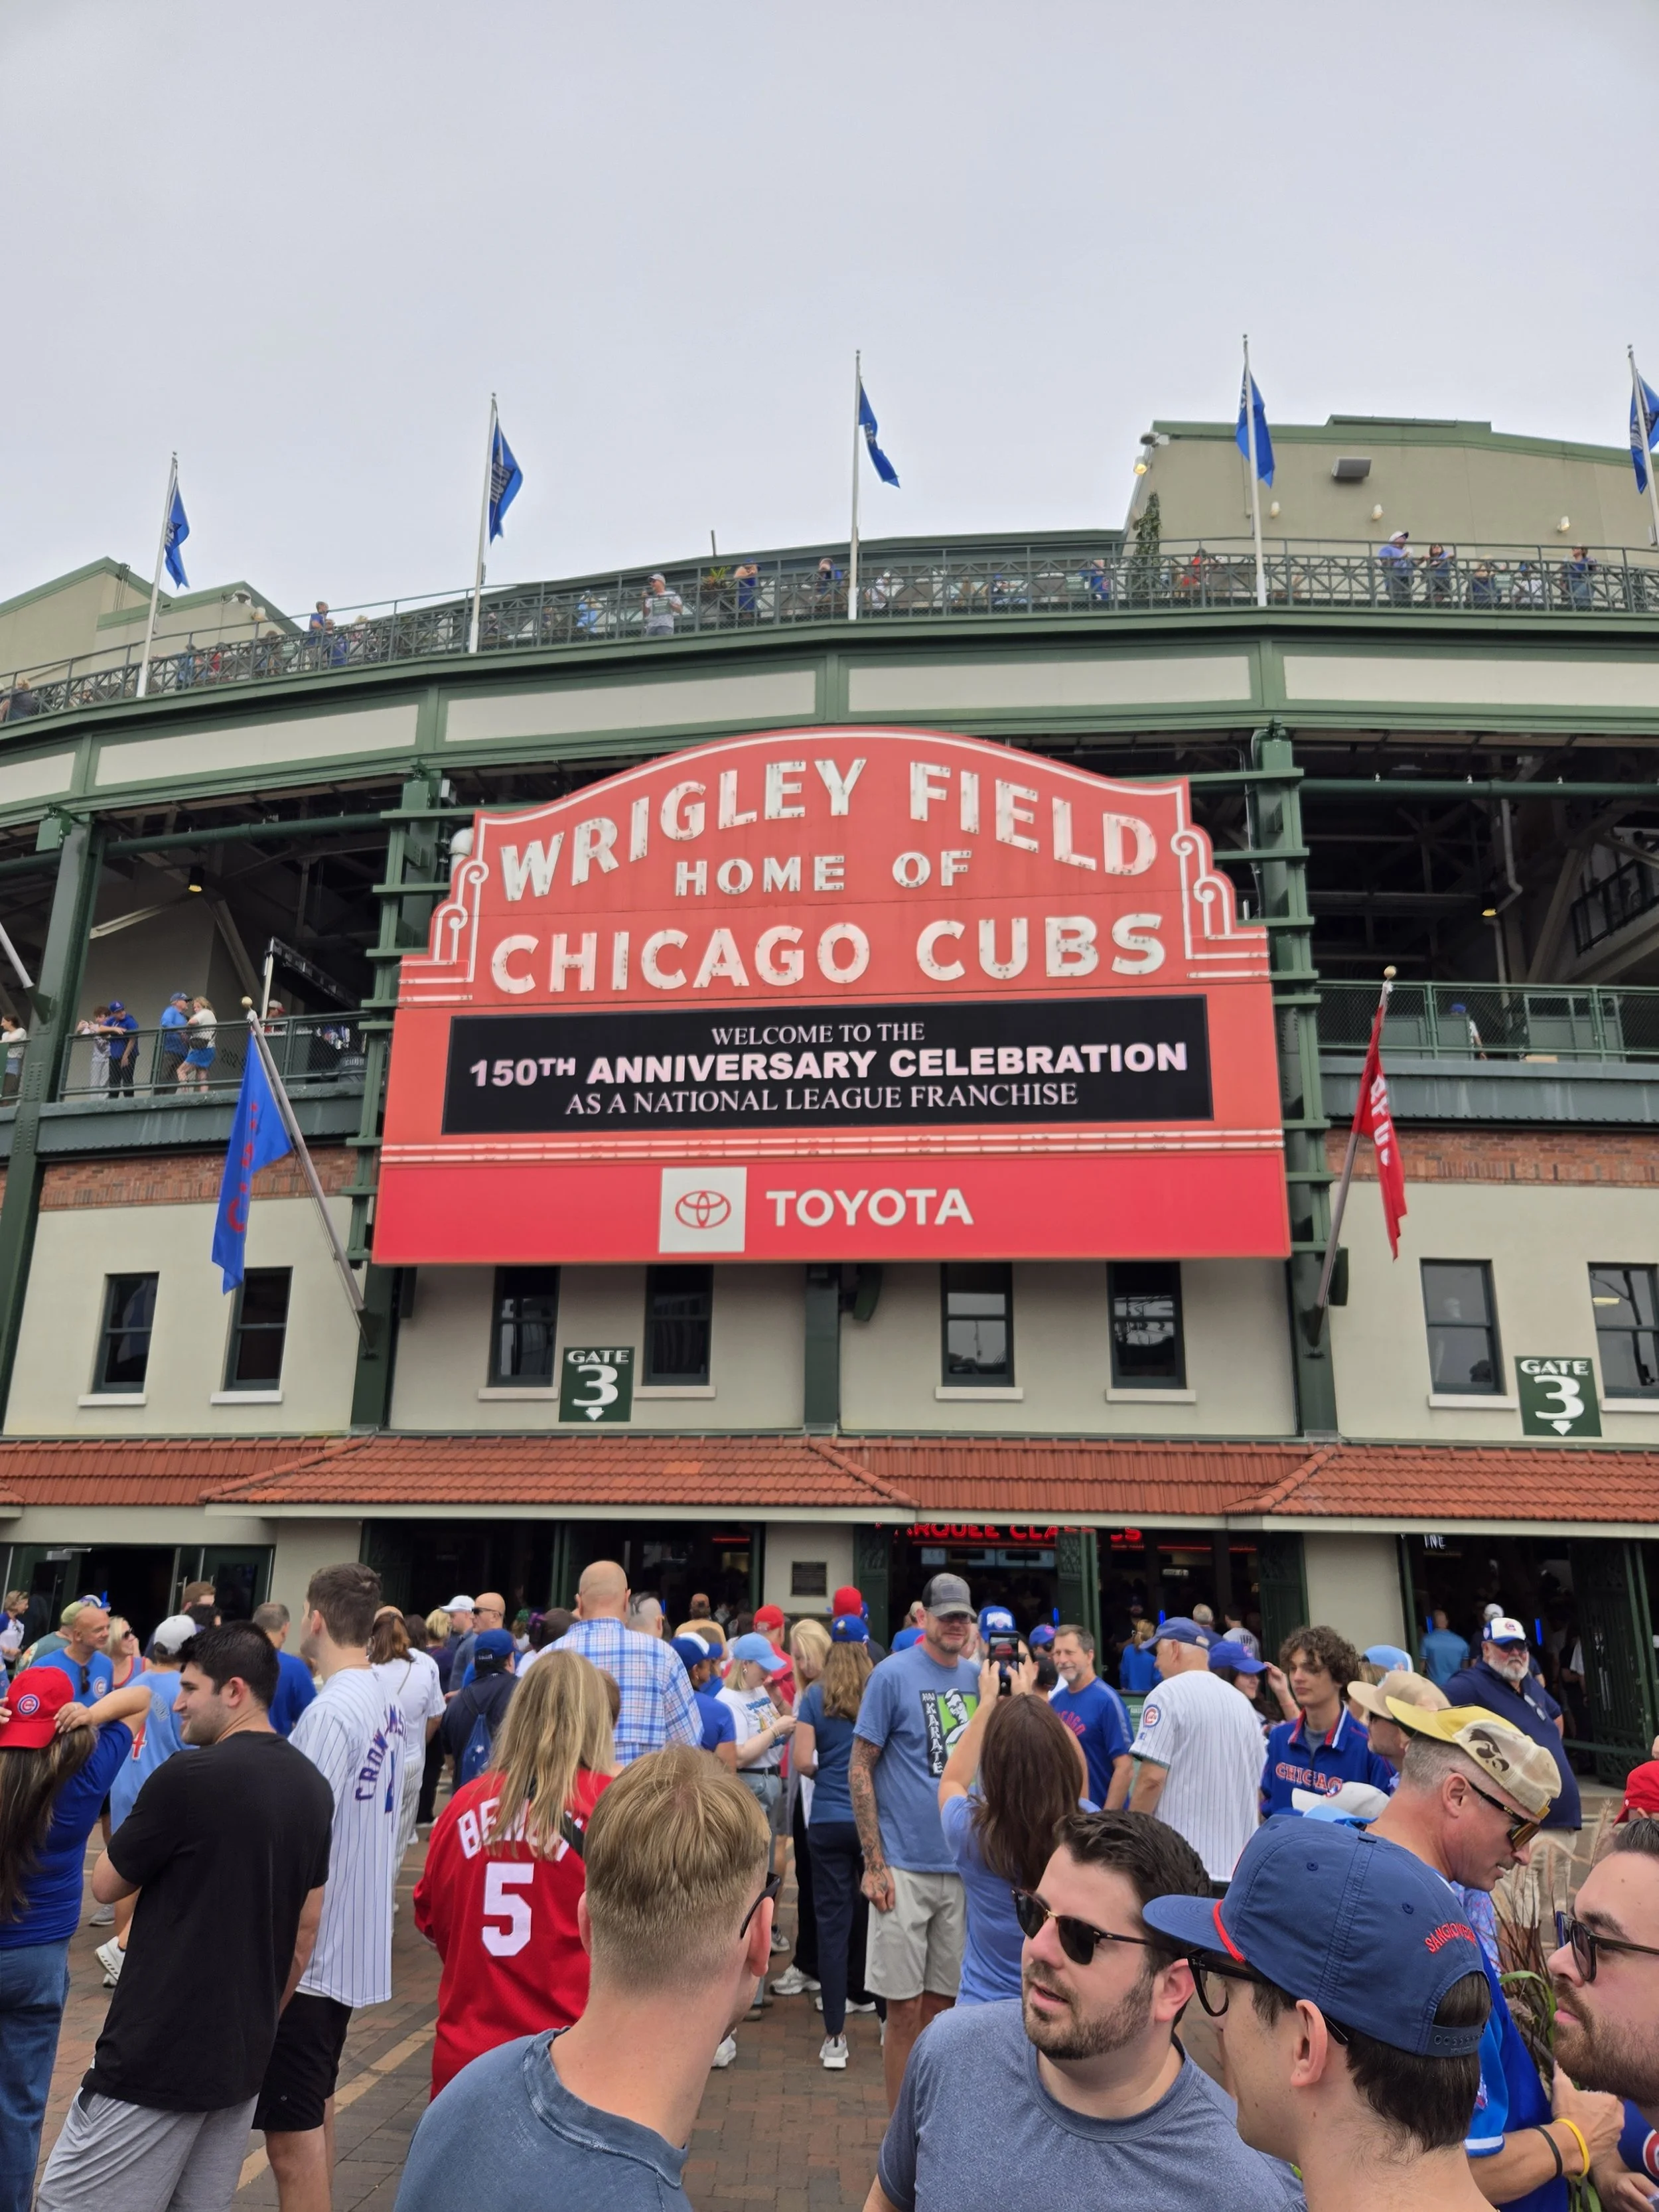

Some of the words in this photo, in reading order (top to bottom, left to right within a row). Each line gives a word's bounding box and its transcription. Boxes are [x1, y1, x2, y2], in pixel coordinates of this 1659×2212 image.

[500, 758, 867, 902] WRIGLEY
[910, 761, 1157, 876] FIELD
[675, 855, 845, 897] HOME
[892, 849, 972, 888] OF
[490, 922, 870, 994] CHICAGO
[916, 913, 1166, 981] CUBS
[711, 1025, 833, 1046] WELCOME
[839, 1024, 871, 1043] TO
[877, 1022, 925, 1041] THE
[470, 1057, 576, 1087] 150TH
[586, 1050, 877, 1084] ANNIVERSARY
[889, 1042, 1188, 1078] CELEBRATION
[565, 1093, 601, 1115] AS
[607, 1093, 627, 1114] A
[634, 1088, 779, 1114] NATIONAL
[786, 1086, 902, 1110] LEAGUE
[910, 1082, 1078, 1108] FRANCHISE
[766, 1188, 974, 1227] TOYOTA
[568, 1350, 630, 1364] GATE
[1520, 1359, 1589, 1376] GATE
[572, 1364, 618, 1407] 3
[1534, 1375, 1585, 1420] 3
[926, 1702, 944, 1774] KARATE
[482, 1862, 535, 1956] 5
